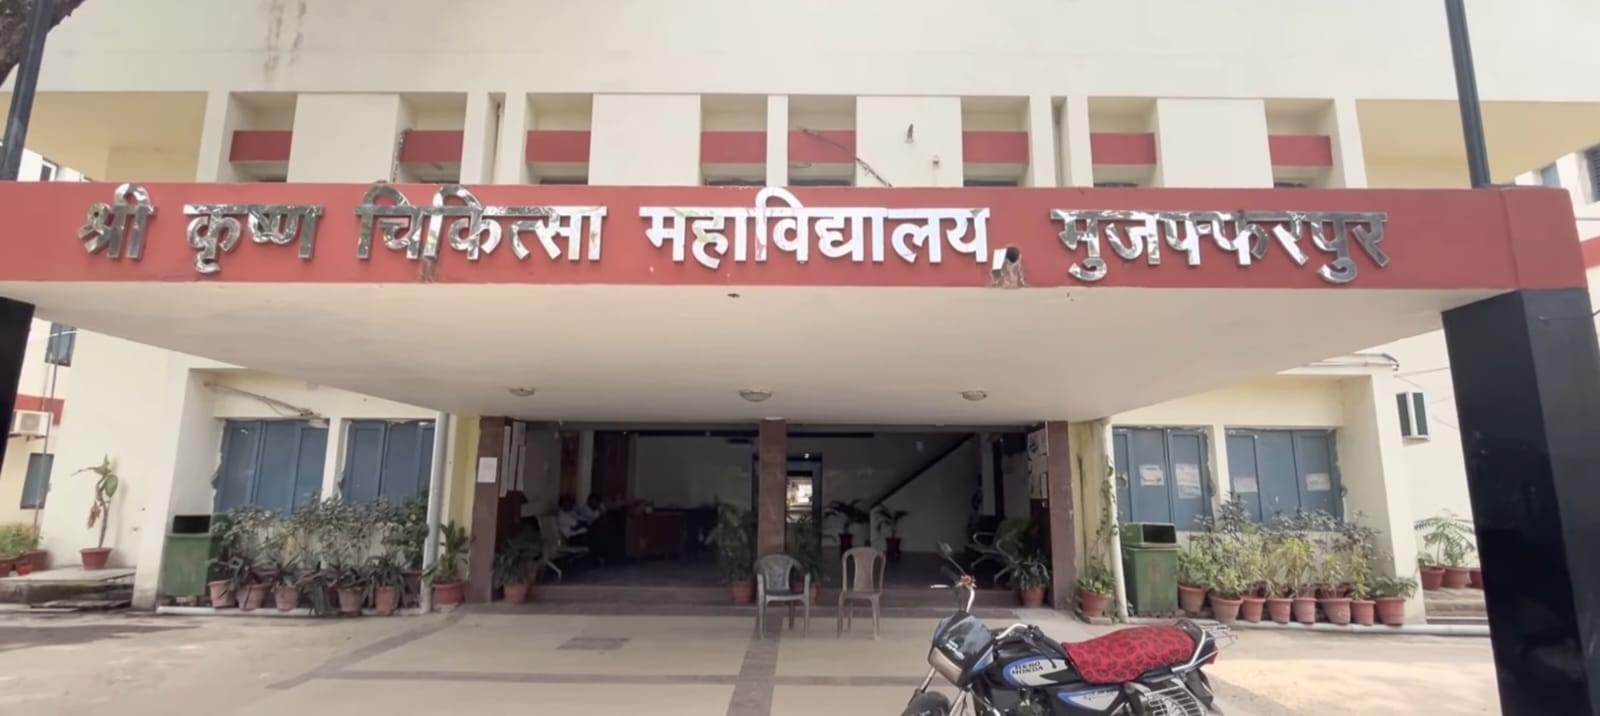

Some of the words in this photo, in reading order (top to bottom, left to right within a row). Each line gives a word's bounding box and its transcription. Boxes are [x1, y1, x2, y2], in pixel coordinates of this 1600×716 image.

[78, 183, 156, 260] श्री
[183, 203, 324, 274] कृष्ण
[354, 182, 608, 261] चिकित्सा
[639, 187, 1007, 271] महाविद्यालय,
[1050, 208, 1391, 284] मुजफ्फरपुर
[1011, 665, 1044, 675] HONDA
